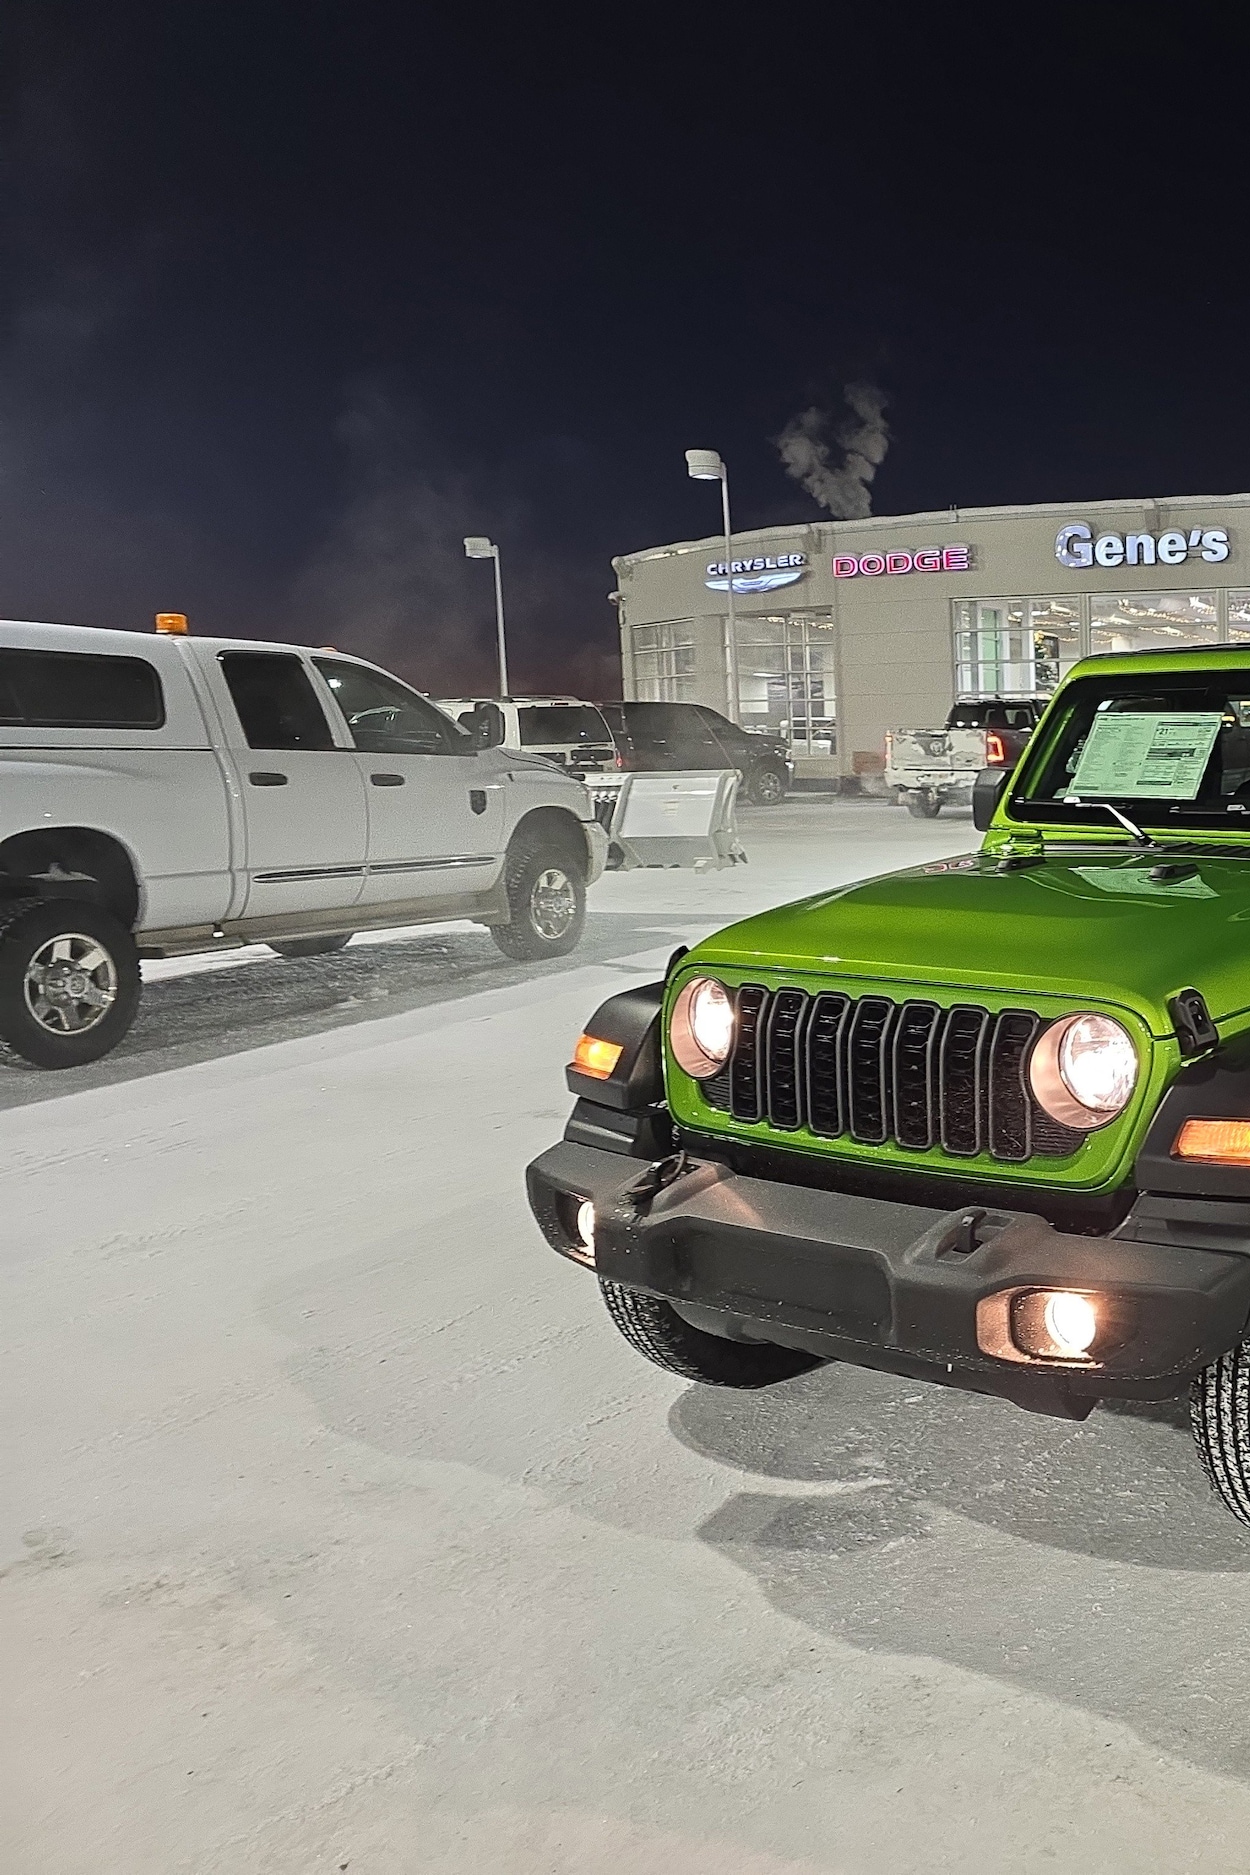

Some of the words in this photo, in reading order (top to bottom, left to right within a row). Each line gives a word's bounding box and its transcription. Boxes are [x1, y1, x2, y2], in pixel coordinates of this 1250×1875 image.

[1055, 525, 1230, 568] Gene's
[706, 554, 804, 576] CHRYSLER
[832, 547, 969, 578] DODGE
